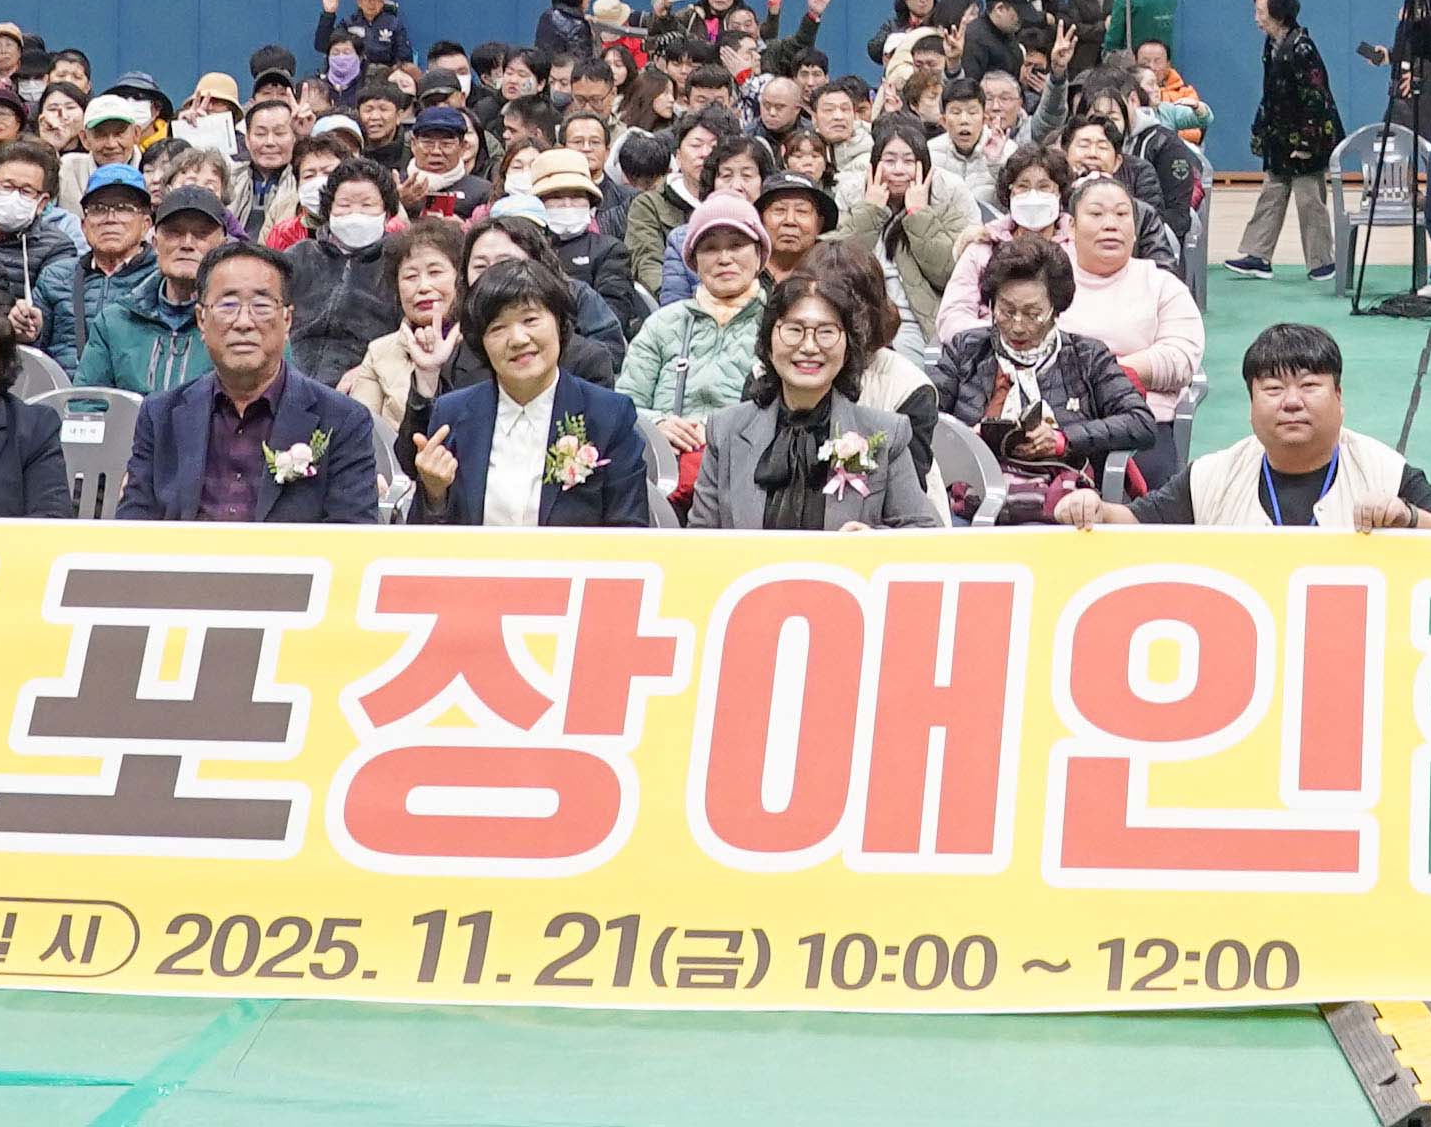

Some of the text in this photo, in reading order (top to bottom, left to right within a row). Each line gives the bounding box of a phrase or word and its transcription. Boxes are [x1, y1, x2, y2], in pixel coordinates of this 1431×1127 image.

[156, 914, 377, 980] 2025.
[413, 909, 511, 984] 11.
[535, 912, 772, 990] 21(금)
[797, 933, 998, 991] 10:00
[1098, 938, 1301, 992] 12:00
